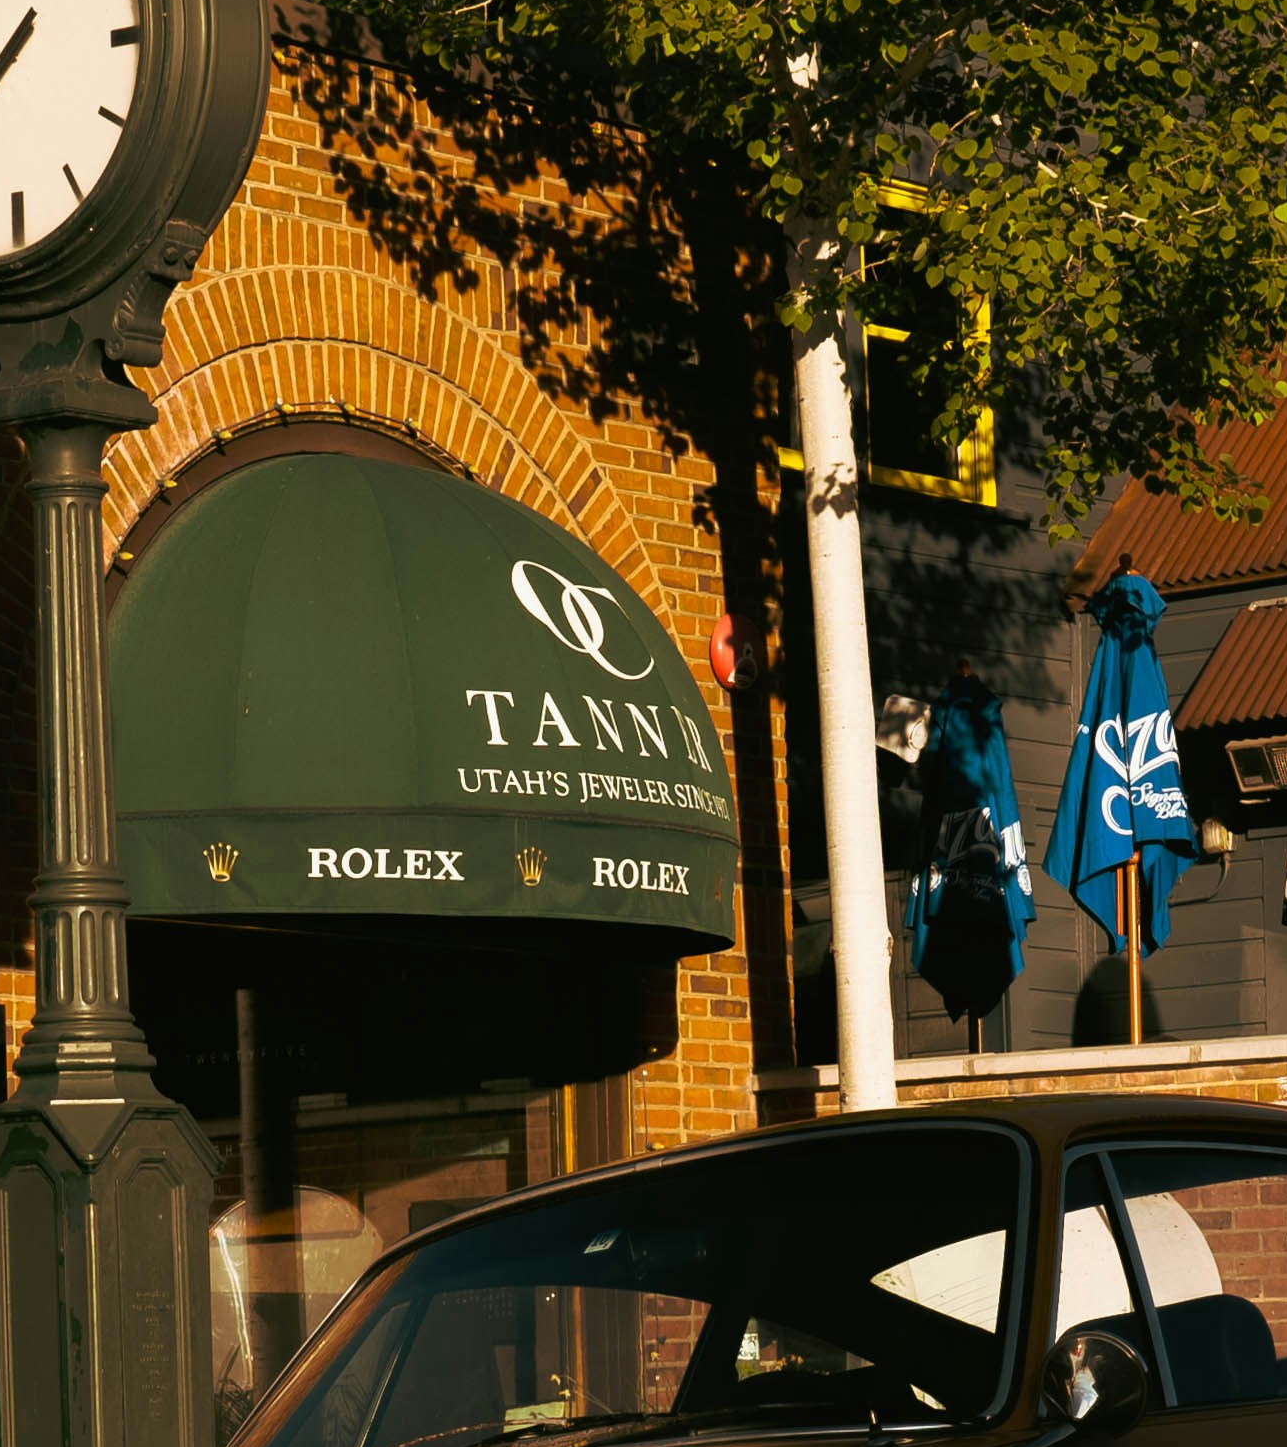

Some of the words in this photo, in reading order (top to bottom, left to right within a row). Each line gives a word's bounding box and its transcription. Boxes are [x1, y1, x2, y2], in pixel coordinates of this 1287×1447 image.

[458, 768, 570, 797] UTAH'S
[578, 772, 675, 806] JEWELER
[674, 783, 716, 816] SINCE
[1155, 801, 1187, 819] Blu
[308, 848, 465, 881] ROLEX
[592, 857, 690, 895] ROLEX
